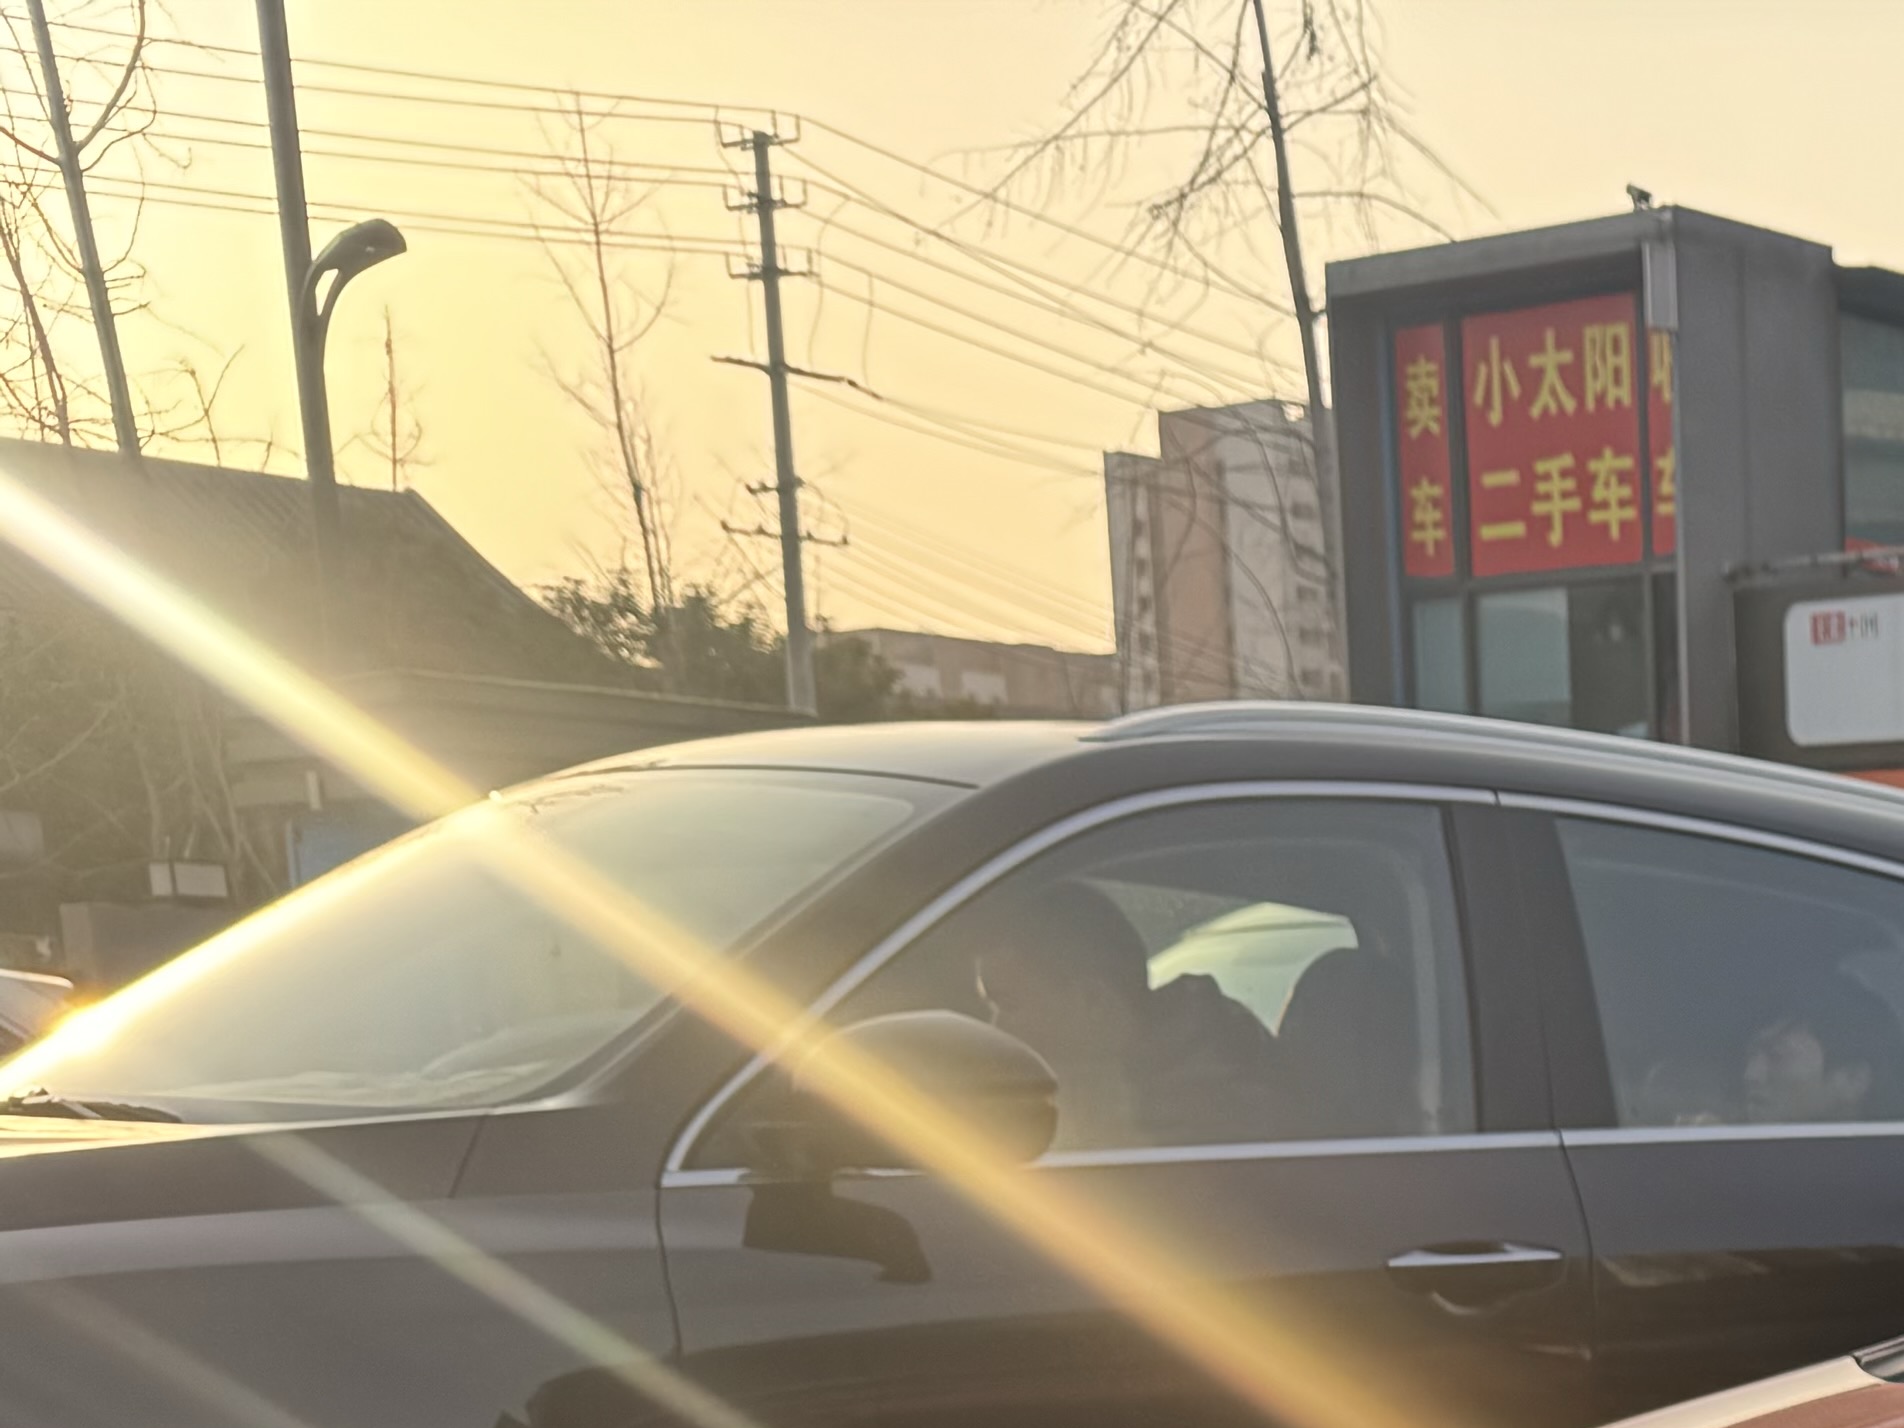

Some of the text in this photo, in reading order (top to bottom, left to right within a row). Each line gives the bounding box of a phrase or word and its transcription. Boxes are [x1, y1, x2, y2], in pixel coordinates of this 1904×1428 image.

[1473, 322, 1632, 428] 小太阳
[1405, 354, 1446, 557] 卖车
[1479, 445, 1638, 549] 二手车
